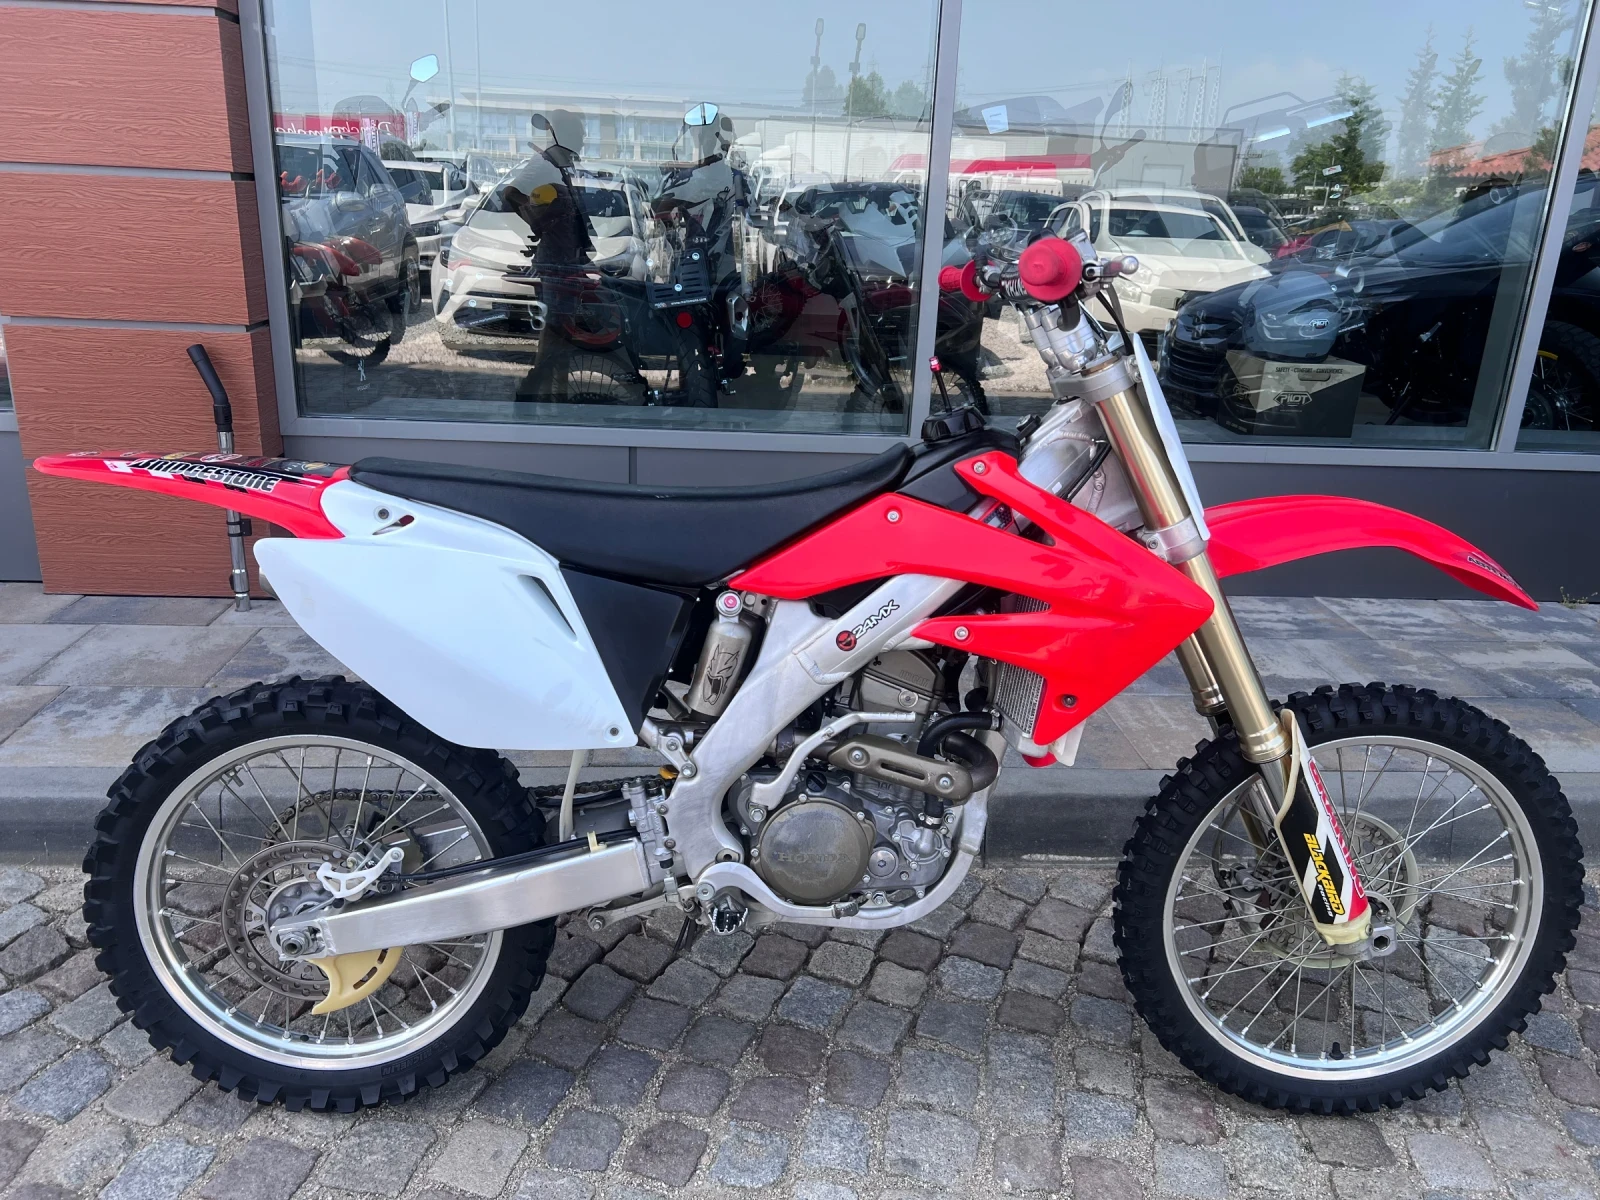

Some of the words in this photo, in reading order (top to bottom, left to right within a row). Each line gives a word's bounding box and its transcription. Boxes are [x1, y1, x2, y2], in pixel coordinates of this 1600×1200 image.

[1311, 319, 1329, 328] PILOT
[1280, 393, 1309, 404] PILOT
[128, 457, 282, 492] BRIDGESTONE
[851, 599, 900, 640] 24MX
[776, 851, 851, 864] HONDA
[1303, 832, 1346, 915] BLACKBIRD
[382, 1048, 433, 1076] MICHELIN
